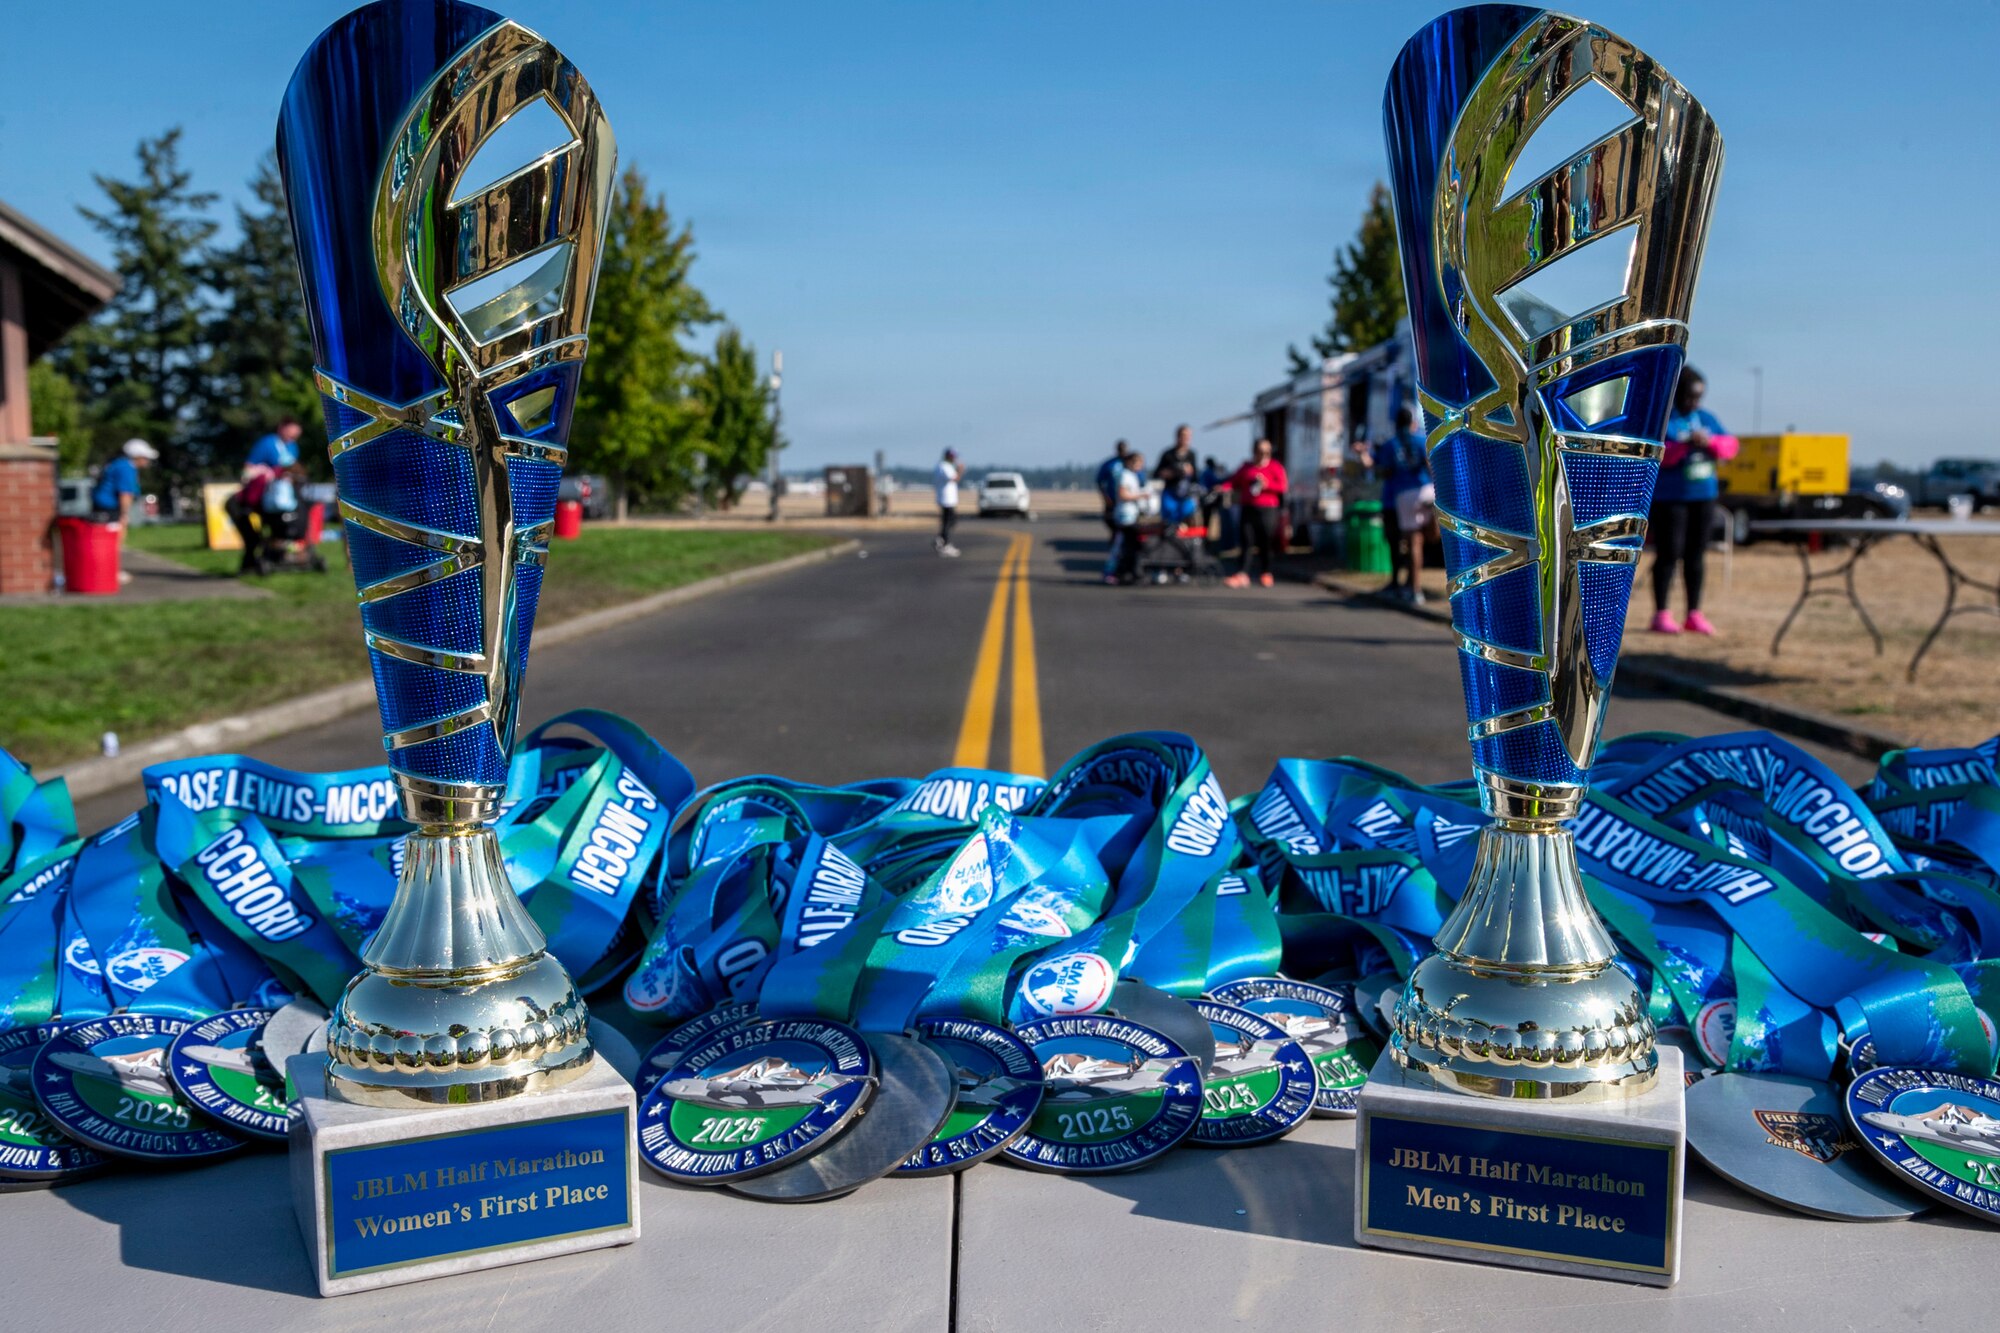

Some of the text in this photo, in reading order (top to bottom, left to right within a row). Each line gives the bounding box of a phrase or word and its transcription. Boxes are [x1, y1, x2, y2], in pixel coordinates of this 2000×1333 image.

[970, 782, 990, 822] &
[1061, 960, 1087, 1006] MWR
[109, 1017, 156, 1035] BASE
[710, 1004, 750, 1026] BASE
[685, 1041, 729, 1073] JOINT
[732, 1024, 775, 1049] BASE
[114, 1096, 190, 1130] 2025
[691, 1116, 769, 1145] 2025
[1058, 1105, 1134, 1139] 2025
[77, 1115, 178, 1152] MARATHON
[653, 1144, 738, 1176] MARATHON
[743, 1149, 758, 1167] &
[762, 1120, 824, 1161] 5K/1K
[47, 1149, 63, 1168] &
[931, 1146, 946, 1163] &
[1037, 1140, 1139, 1165] MARATHON
[352, 1148, 605, 1201] JBLM Half Marathon
[1388, 1148, 1646, 1197] JBLM Half Marathon
[353, 1183, 609, 1239] Women’s First Place
[1405, 1185, 1626, 1233] Men’s First Place
